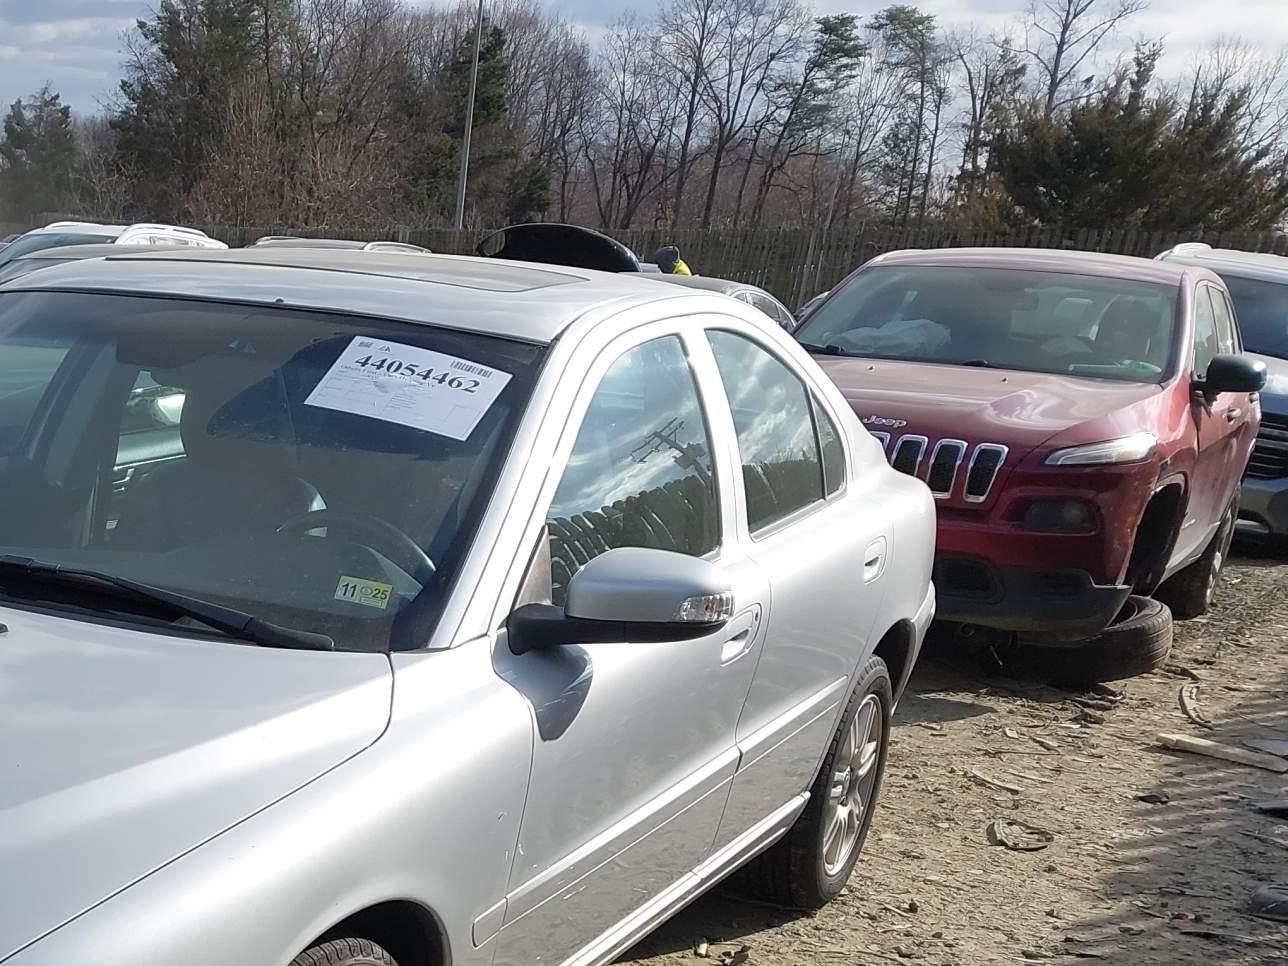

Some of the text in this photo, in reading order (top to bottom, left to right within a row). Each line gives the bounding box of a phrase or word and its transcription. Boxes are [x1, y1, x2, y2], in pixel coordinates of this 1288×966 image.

[355, 354, 481, 394] 44054462
[862, 415, 907, 428] Jeep
[342, 582, 389, 600] 11 25
